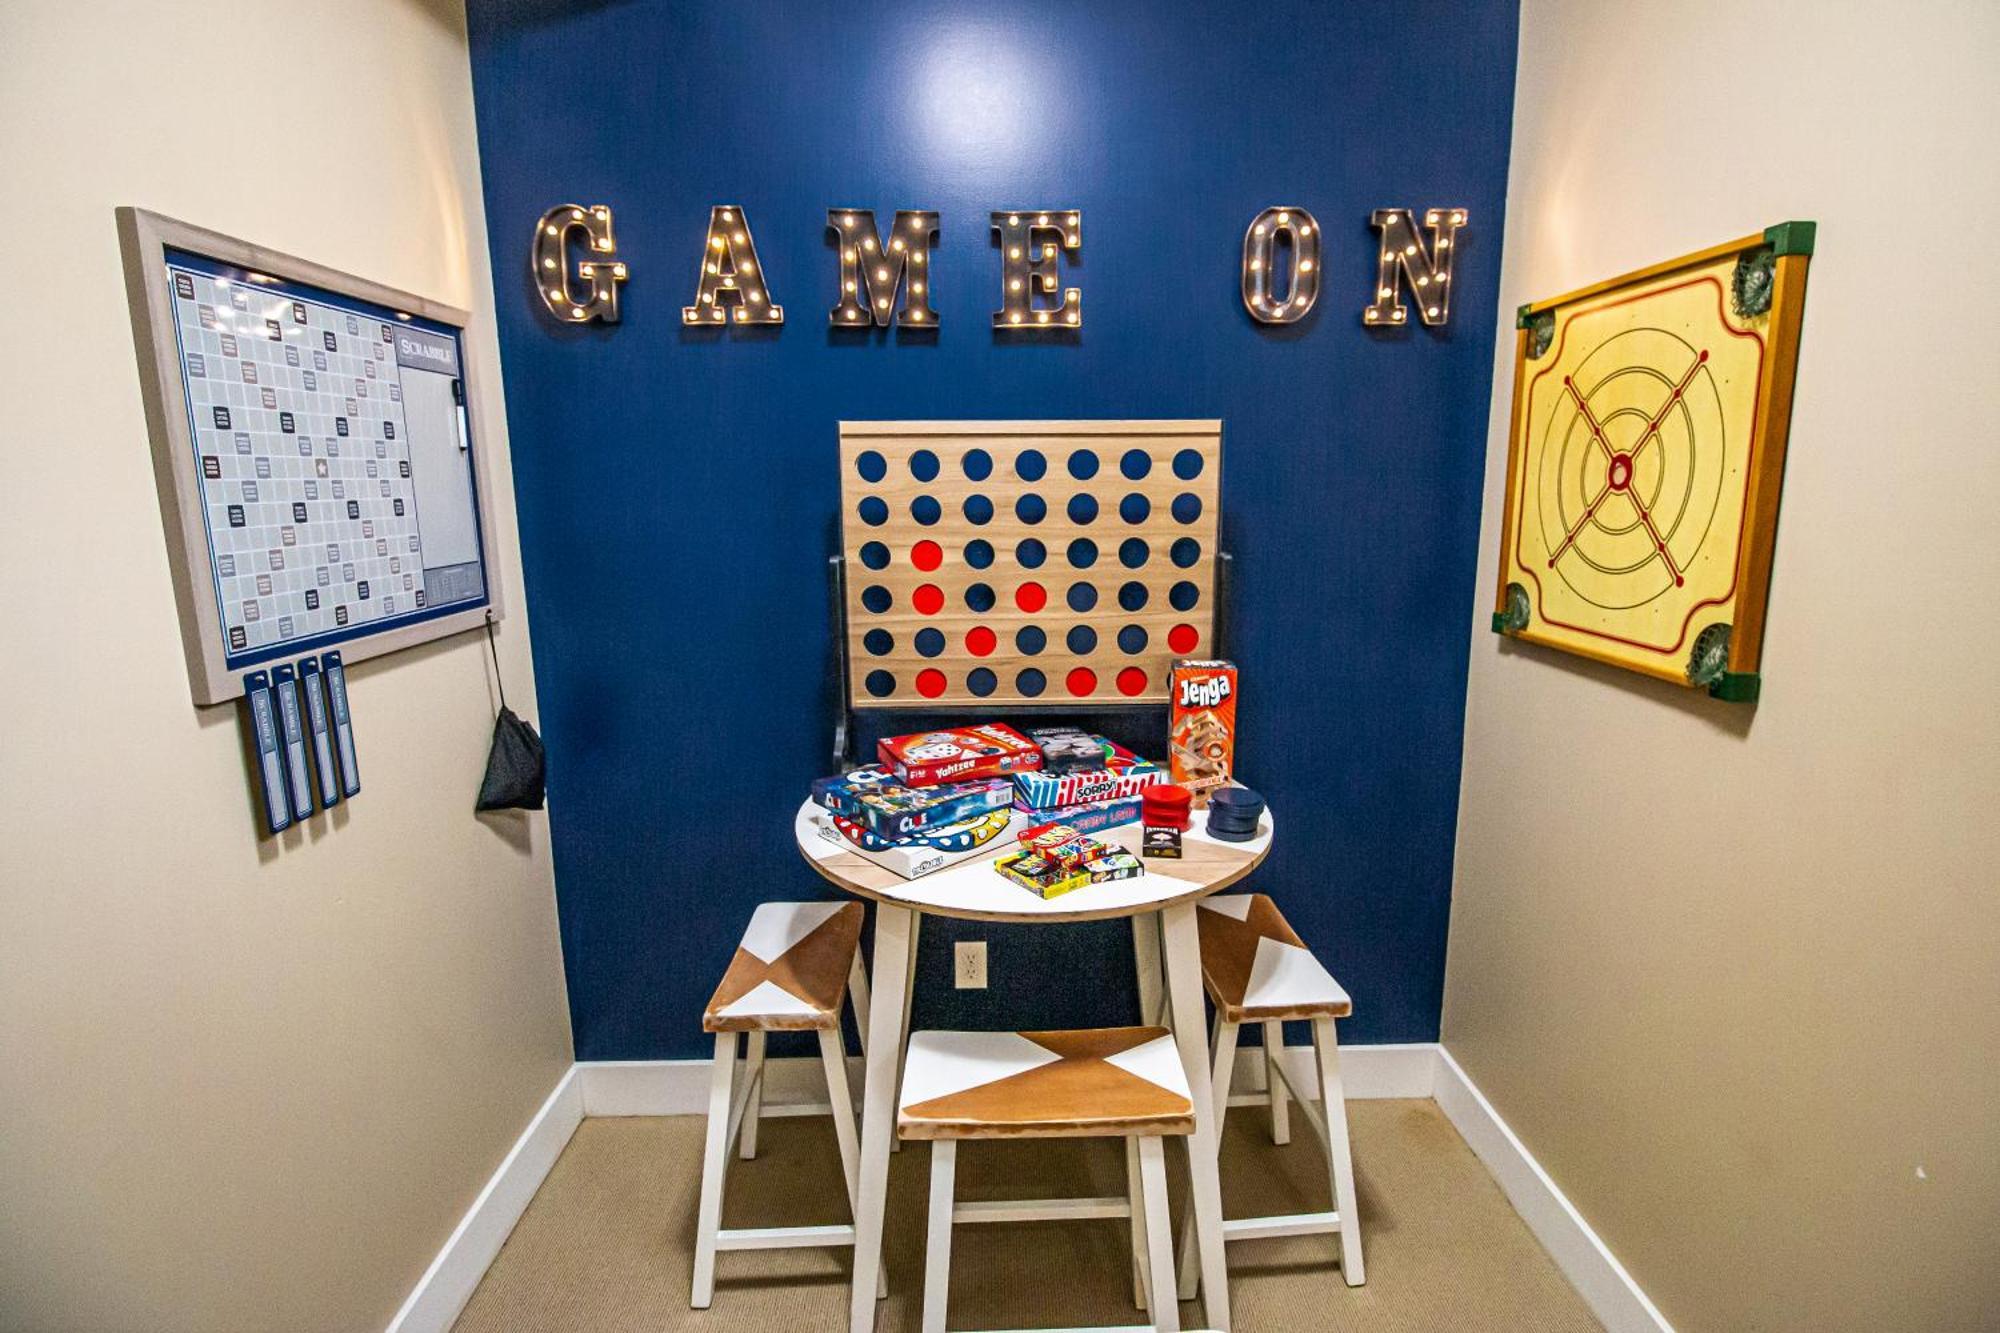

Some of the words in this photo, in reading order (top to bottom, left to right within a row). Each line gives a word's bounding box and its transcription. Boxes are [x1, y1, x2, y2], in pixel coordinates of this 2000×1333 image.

[531, 203, 1082, 329] GAME
[1241, 206, 1469, 326] ON
[1180, 675, 1230, 706] Jenga
[934, 759, 976, 779] Yahtzee
[900, 812, 927, 832] CLUE
